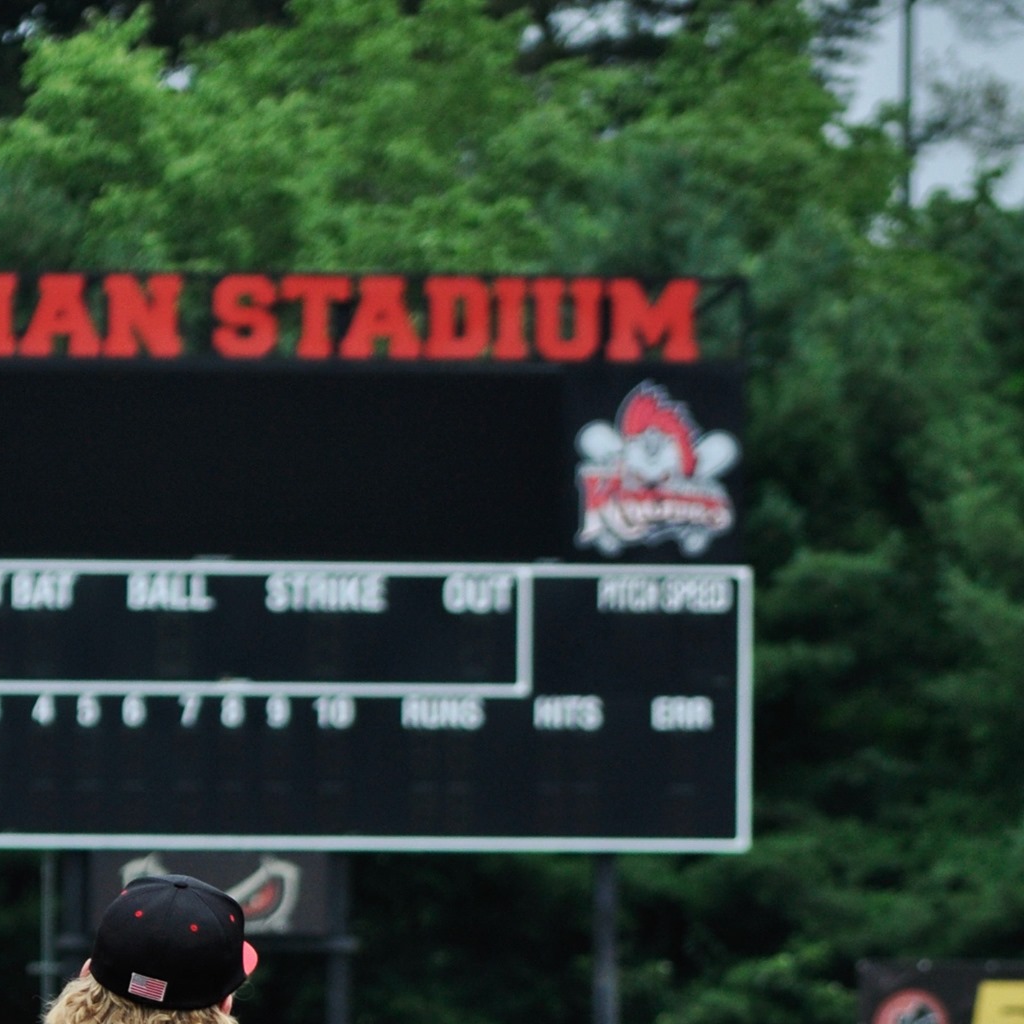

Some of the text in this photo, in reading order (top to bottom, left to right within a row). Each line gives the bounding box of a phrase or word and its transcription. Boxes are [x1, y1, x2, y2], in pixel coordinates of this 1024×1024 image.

[212, 273, 700, 364] STADIUM
[11, 570, 77, 610] BAT
[126, 572, 215, 612] BALL
[265, 573, 387, 614] STRIKE
[442, 574, 516, 614] OUT
[596, 576, 734, 615] PITCH SPEED
[31, 693, 57, 728] 4
[76, 694, 102, 728] 5
[122, 694, 148, 728] 6
[179, 695, 203, 728] 7
[220, 695, 246, 729] 8
[265, 695, 292, 729] 9
[312, 696, 356, 729] 10
[401, 697, 486, 731] RUNS
[533, 696, 605, 731] HITS
[650, 696, 715, 731] ERR
